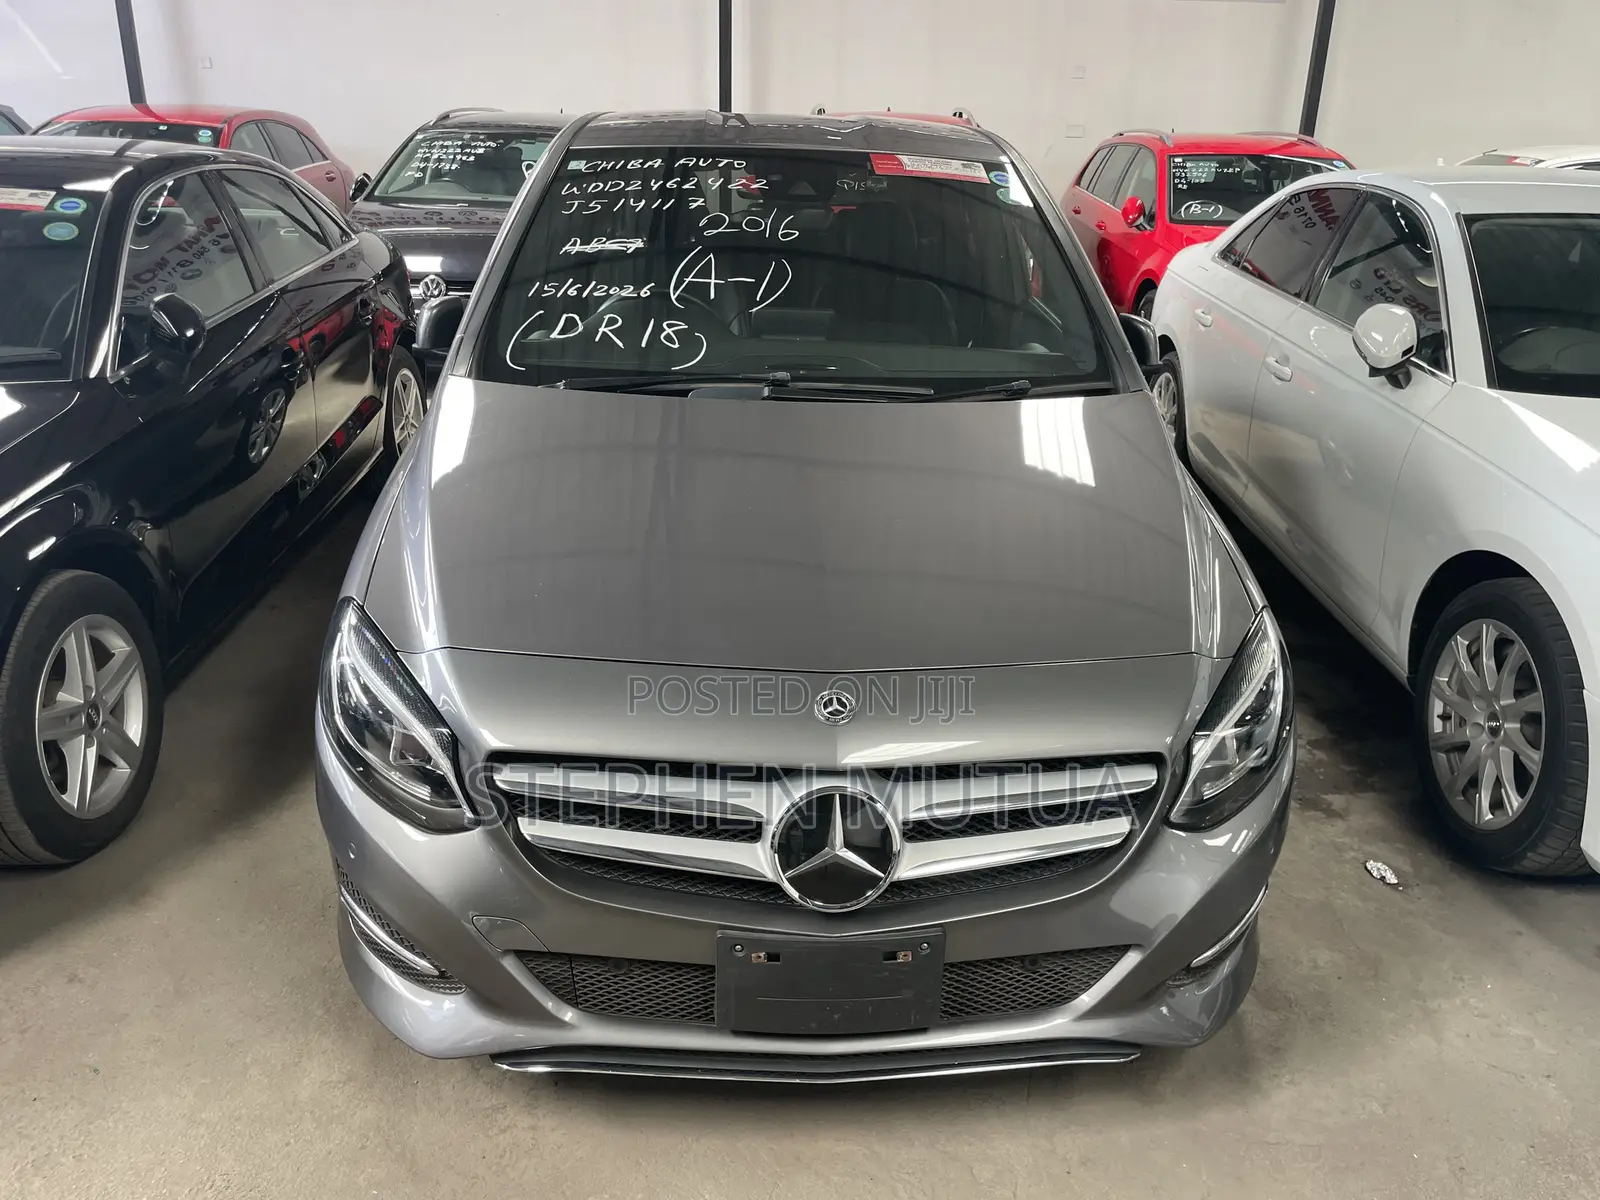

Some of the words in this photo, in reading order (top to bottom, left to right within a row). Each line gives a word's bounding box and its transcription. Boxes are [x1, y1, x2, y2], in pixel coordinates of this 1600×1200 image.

[582, 158, 663, 174] CHIBA
[674, 158, 747, 169] AUTO
[1181, 201, 1223, 219] (B-1)
[699, 208, 800, 241] 2016
[669, 246, 792, 312] (A-1)
[528, 281, 655, 299] 15/6/2026
